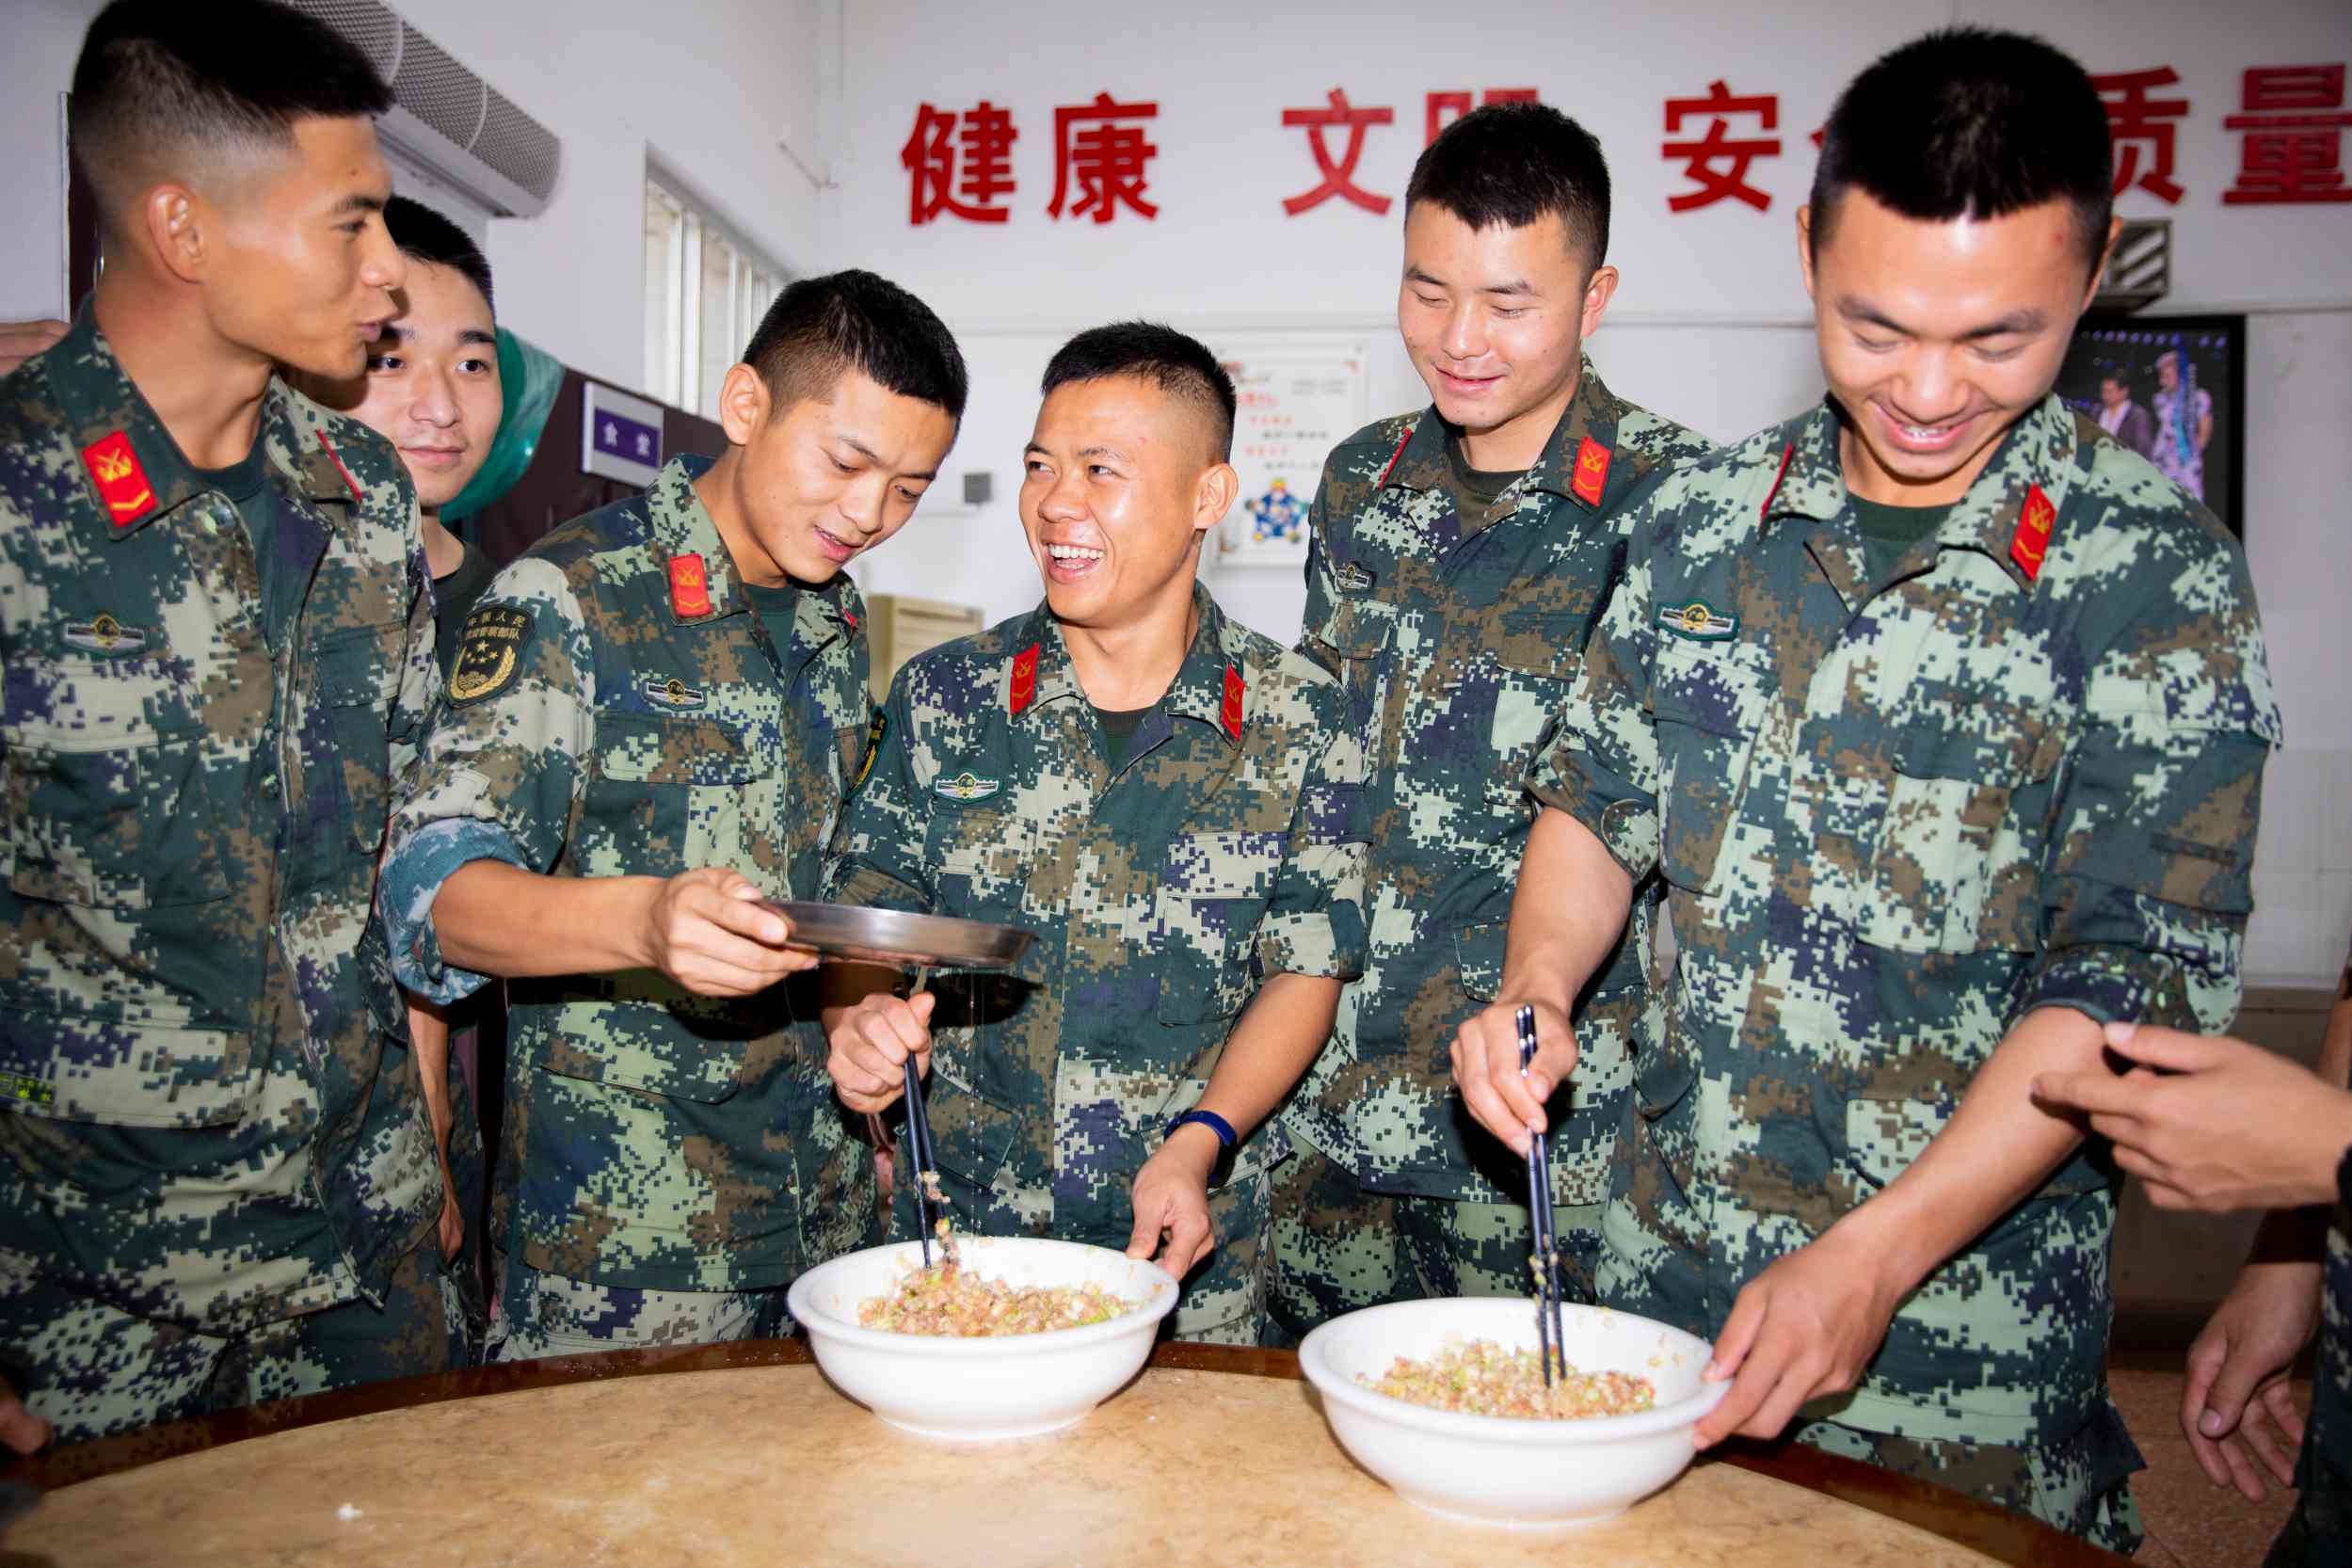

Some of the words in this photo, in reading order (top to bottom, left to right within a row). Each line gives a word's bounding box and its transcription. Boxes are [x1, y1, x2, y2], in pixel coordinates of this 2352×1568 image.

[901, 91, 1160, 226] 健康
[1661, 80, 1824, 212] 安
[2087, 63, 2352, 204] 质量
